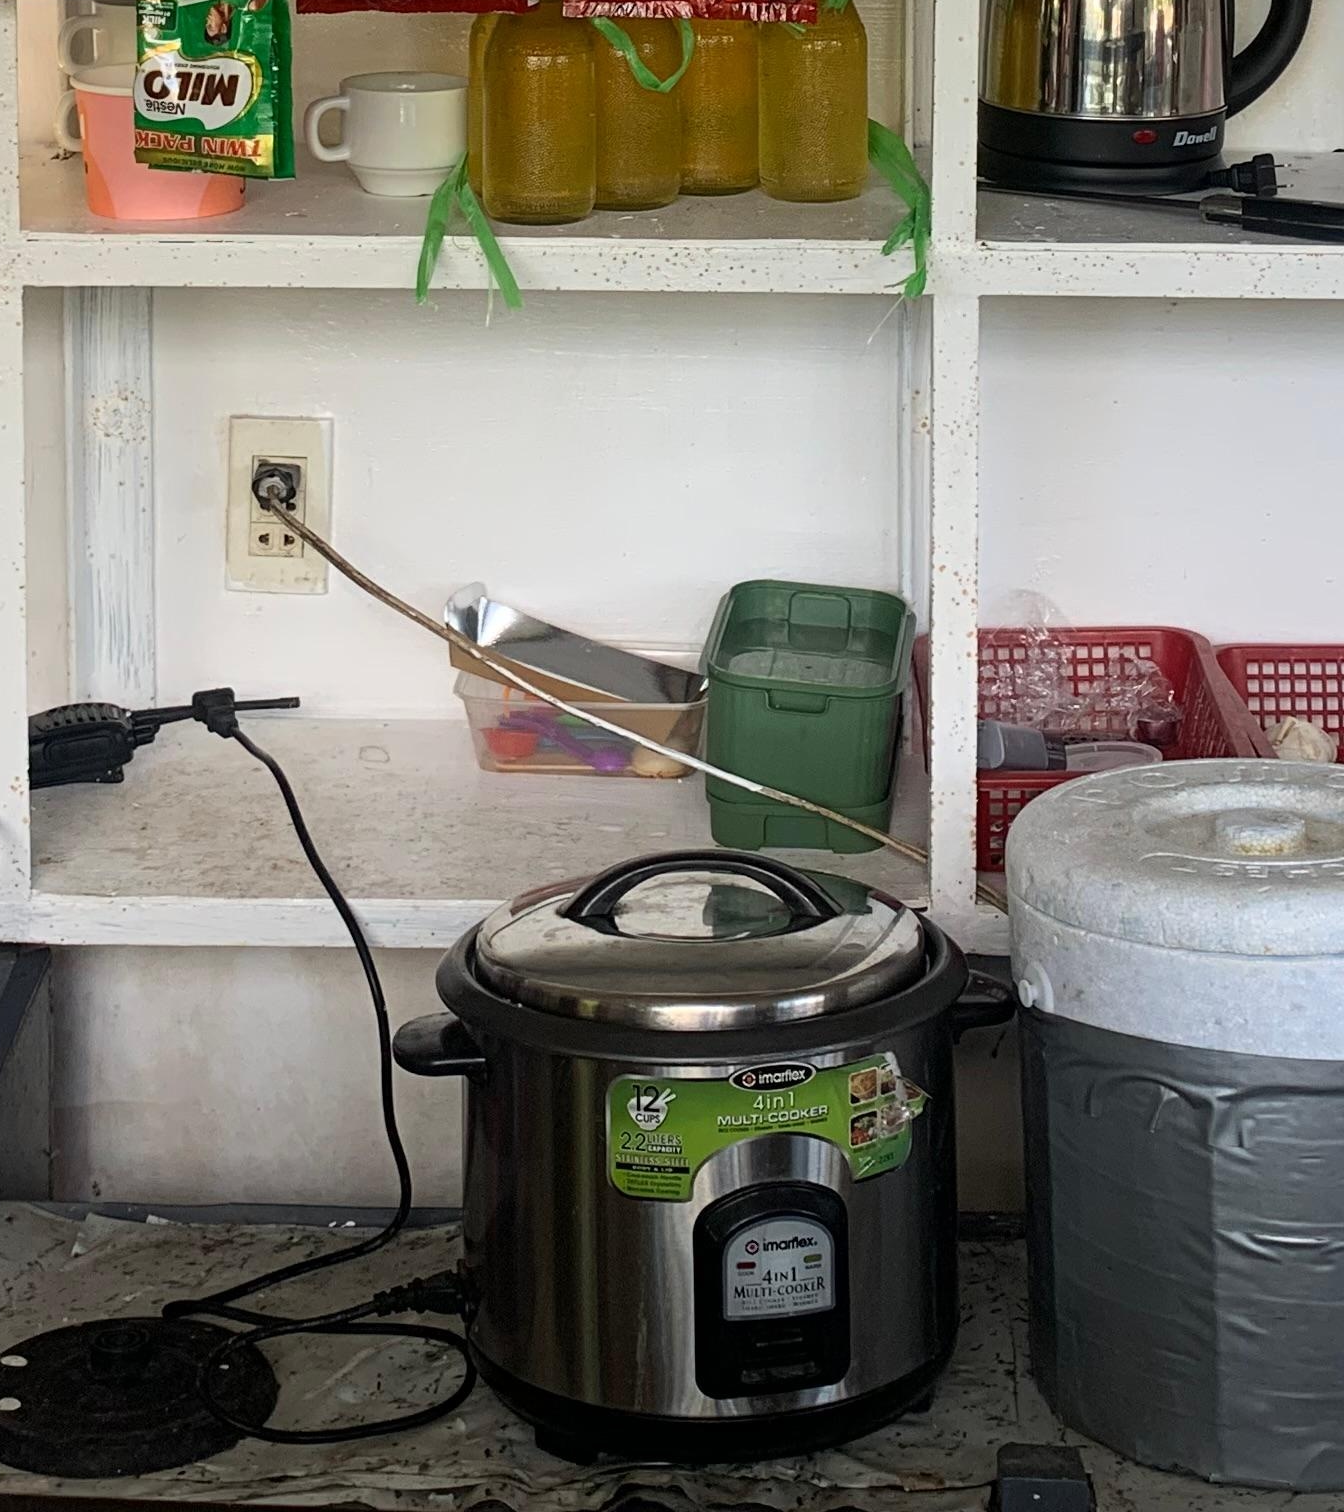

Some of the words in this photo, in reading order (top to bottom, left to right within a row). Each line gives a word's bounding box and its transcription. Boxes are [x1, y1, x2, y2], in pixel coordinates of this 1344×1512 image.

[143, 68, 241, 107] MILO
[1172, 125, 1219, 148] Dowell
[758, 1068, 807, 1086] imarflex
[632, 1084, 660, 1113] 12
[635, 1113, 661, 1124] CUPS
[716, 1104, 829, 1127] MULTI-COOKER
[733, 1275, 826, 1300] MULTI-COOKER
